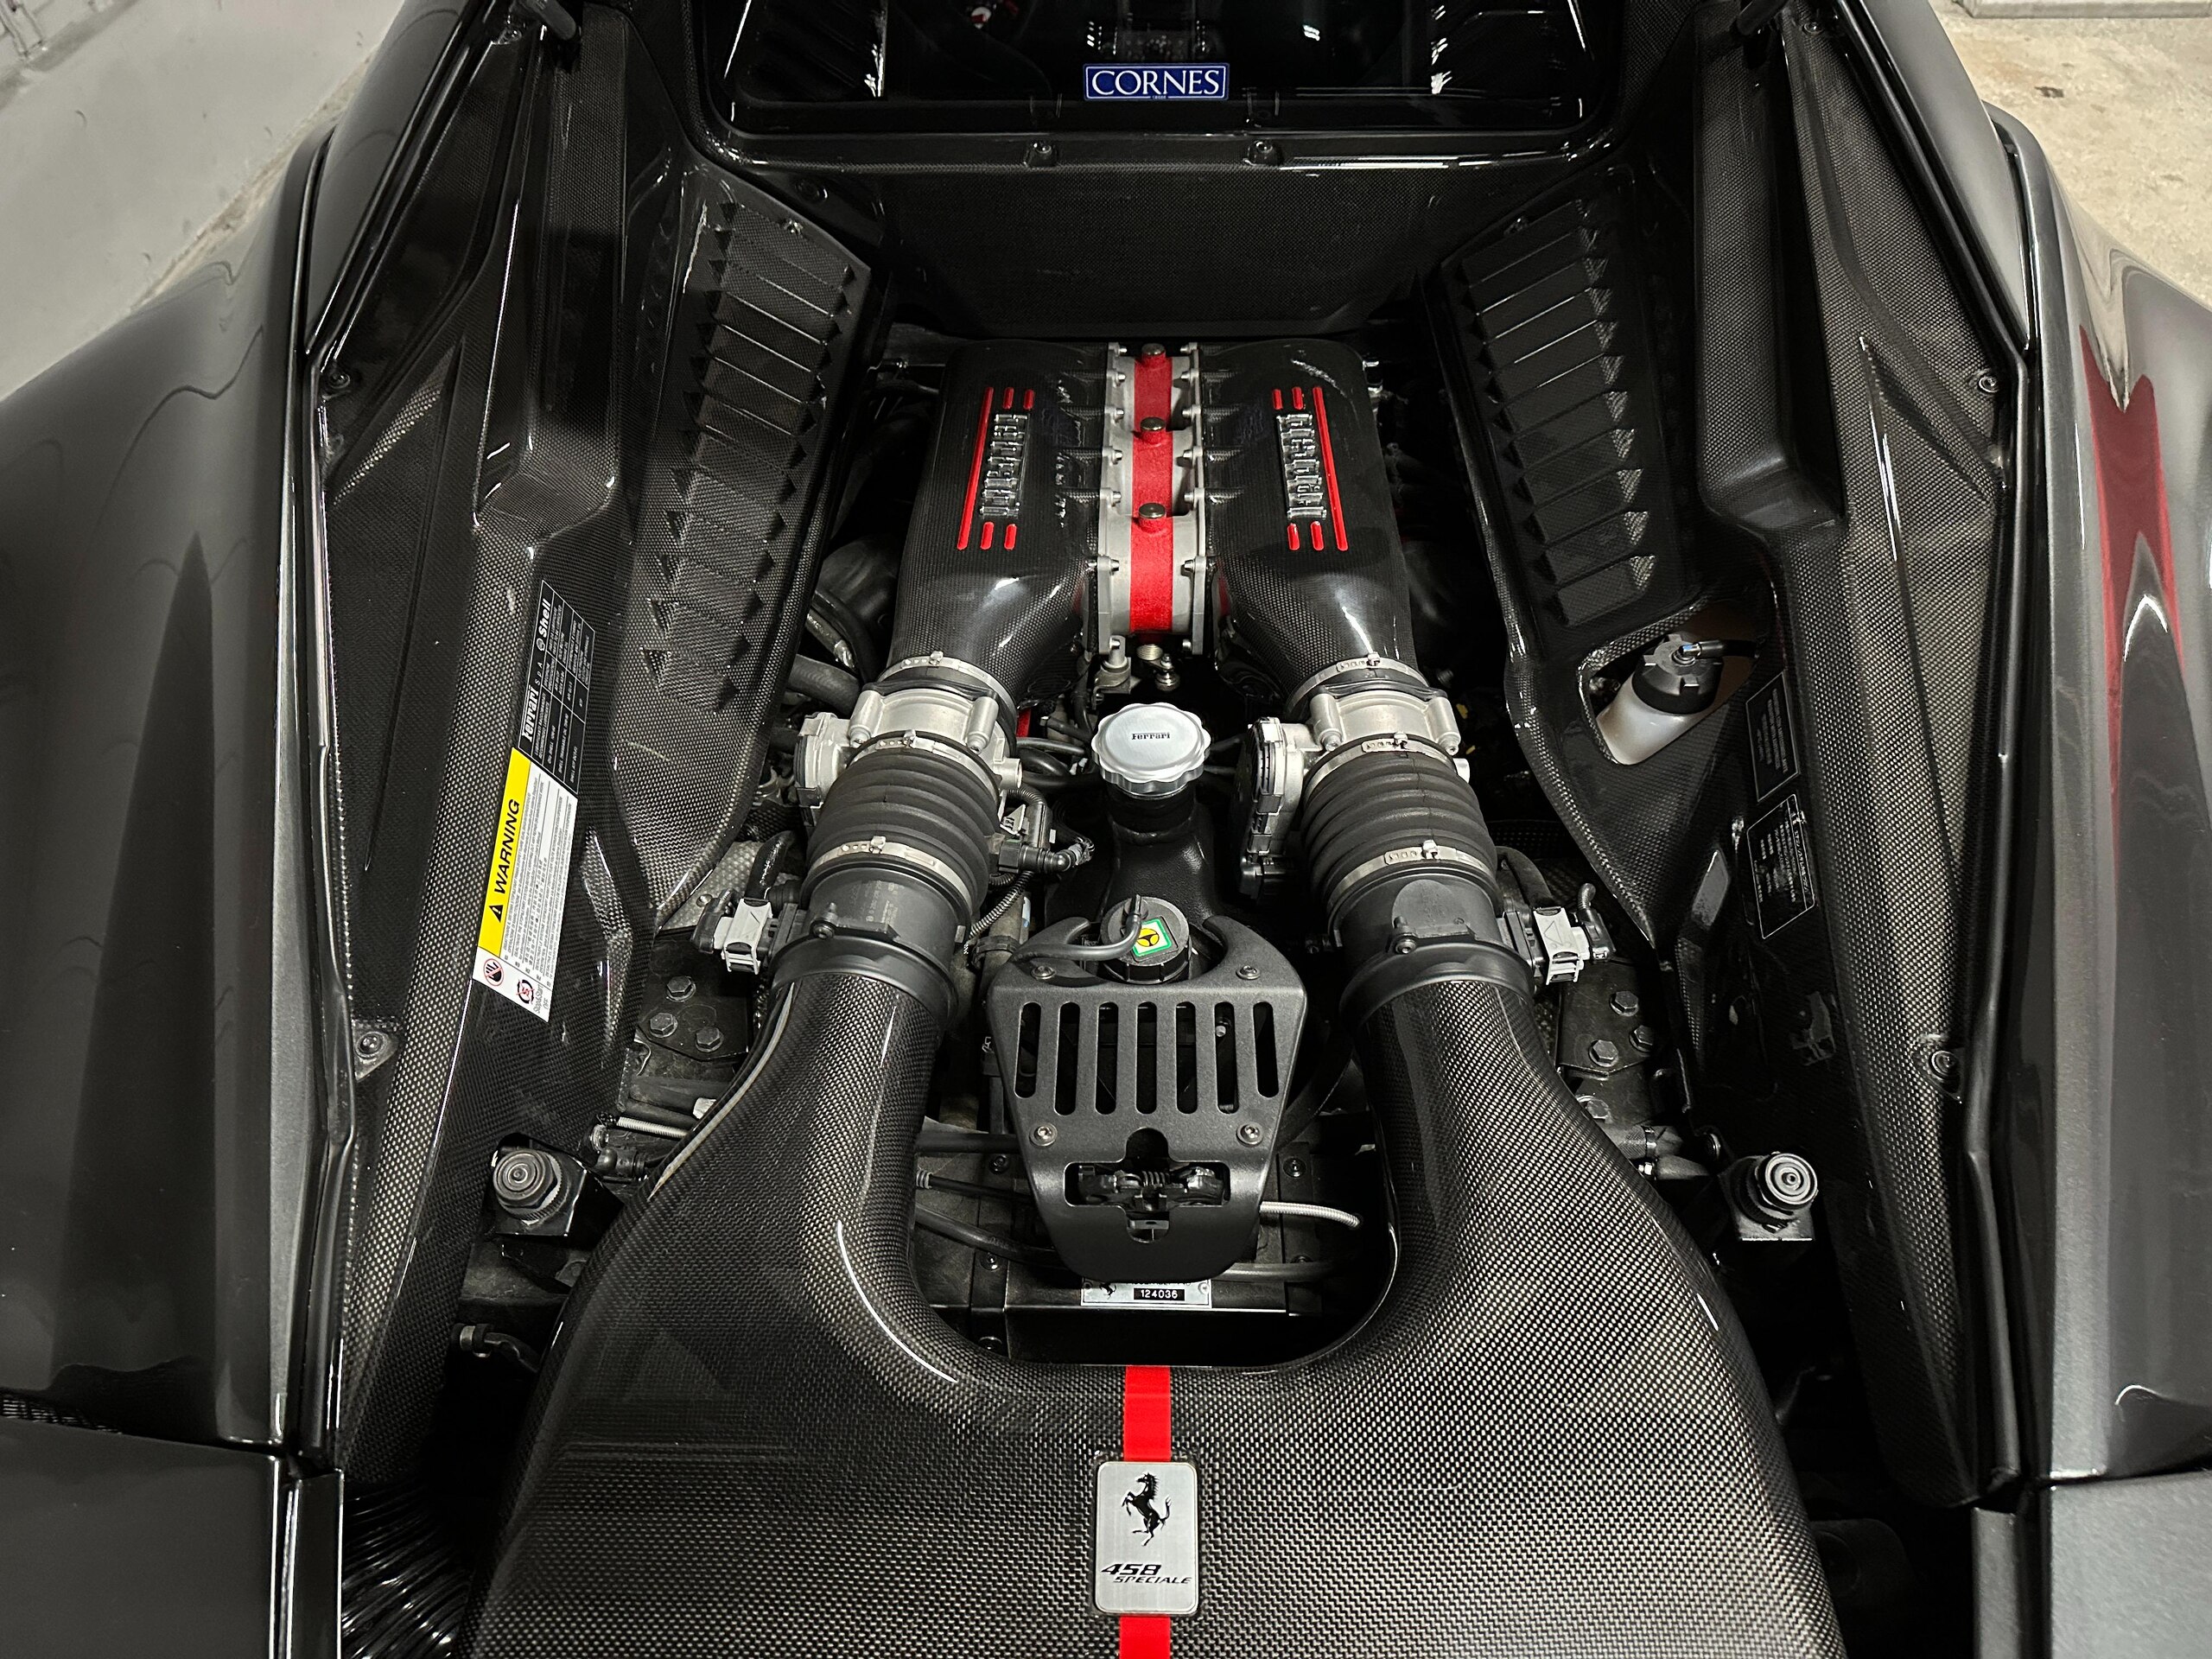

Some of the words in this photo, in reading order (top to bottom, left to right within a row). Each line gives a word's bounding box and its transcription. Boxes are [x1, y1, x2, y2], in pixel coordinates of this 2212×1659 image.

[1091, 70, 1220, 96] CORNES
[522, 685, 539, 742] Ferrari
[537, 599, 551, 639] Shell
[494, 798, 520, 894] WARNING
[1141, 1289, 1179, 1299] 124036
[1101, 1563, 1162, 1575] 458
